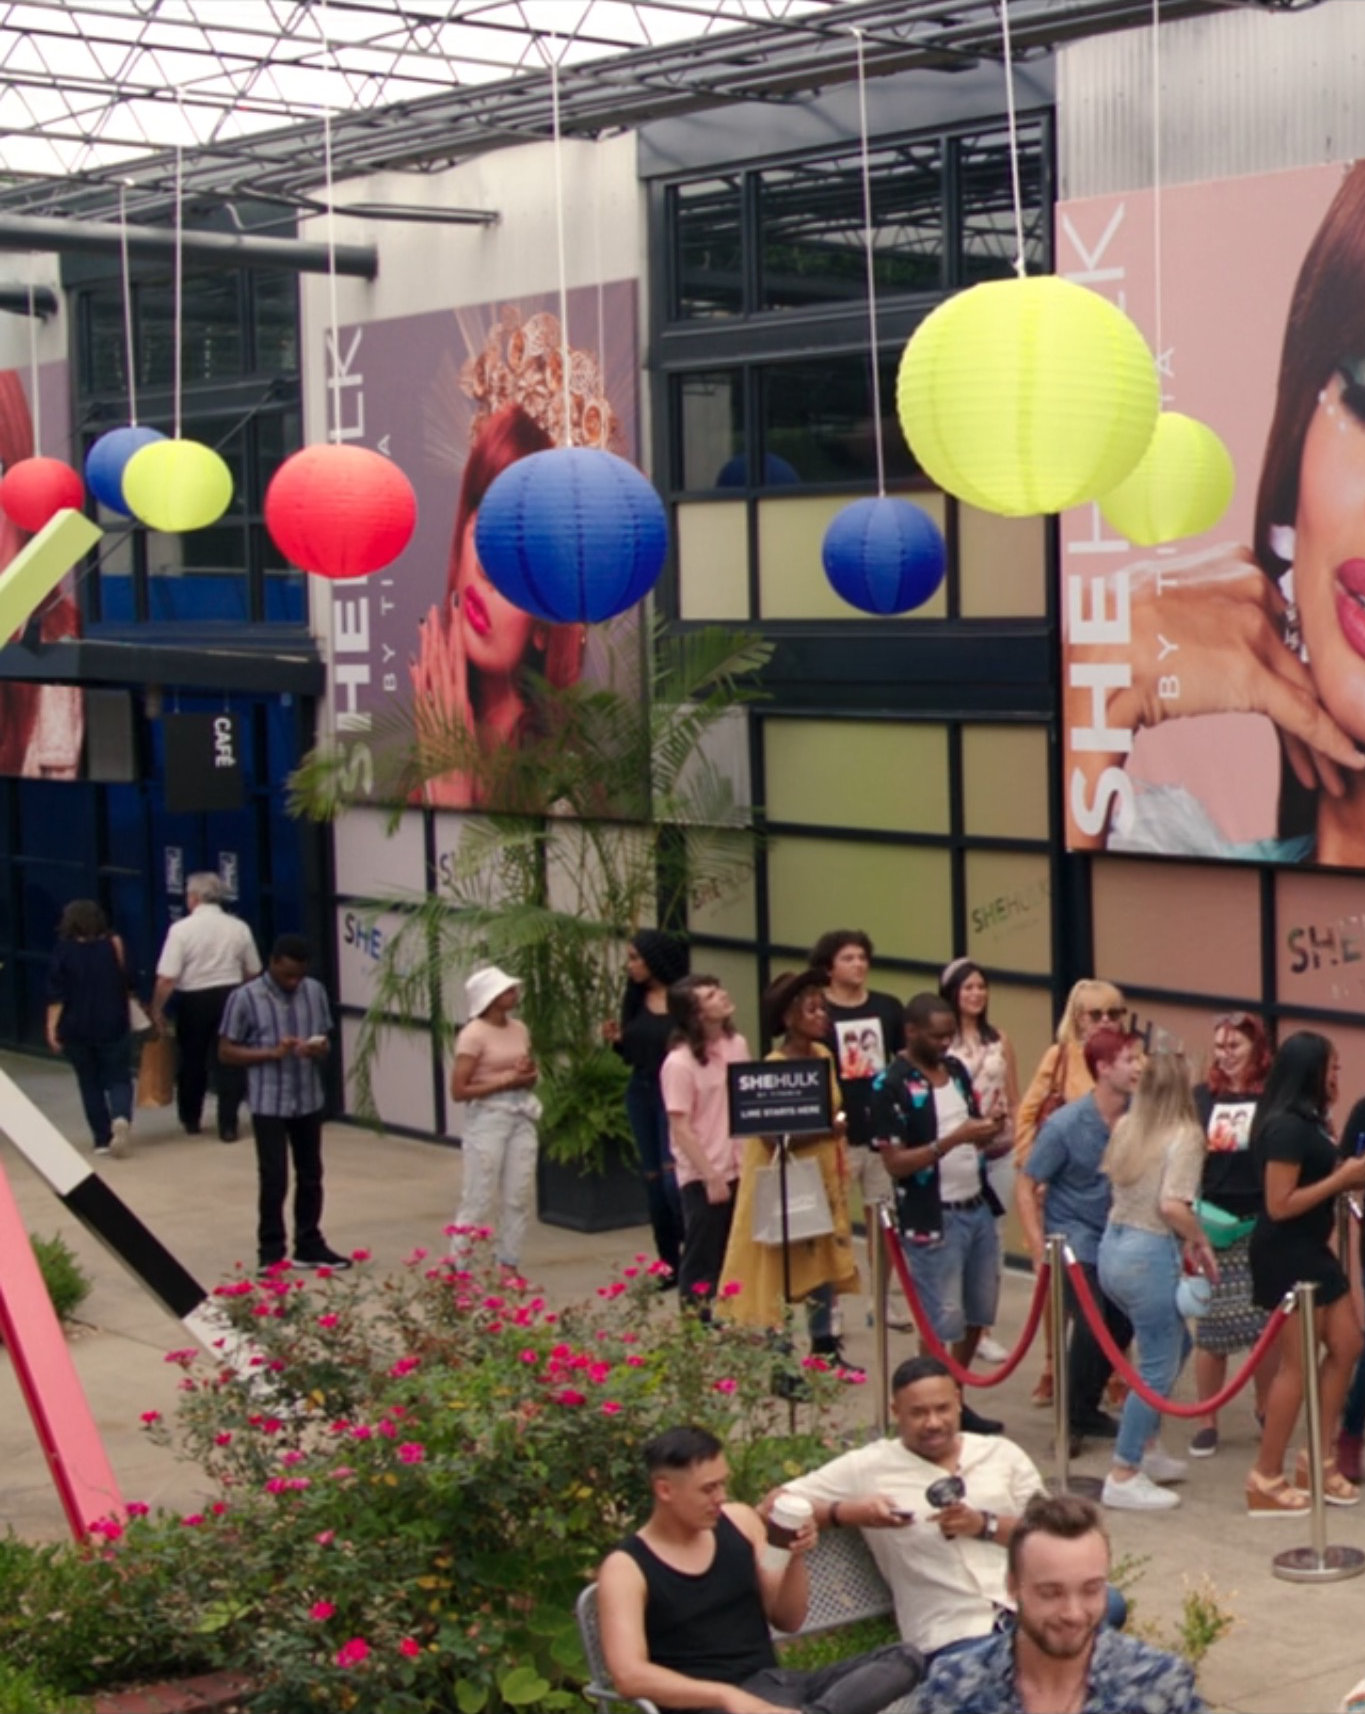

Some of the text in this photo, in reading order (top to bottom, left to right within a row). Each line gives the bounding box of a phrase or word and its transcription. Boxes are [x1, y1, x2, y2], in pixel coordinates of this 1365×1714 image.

[382, 642, 398, 691] BY
[1157, 632, 1181, 699] BY
[213, 717, 237, 768] CAFÉ
[738, 1071, 820, 1091] SHEHULK
